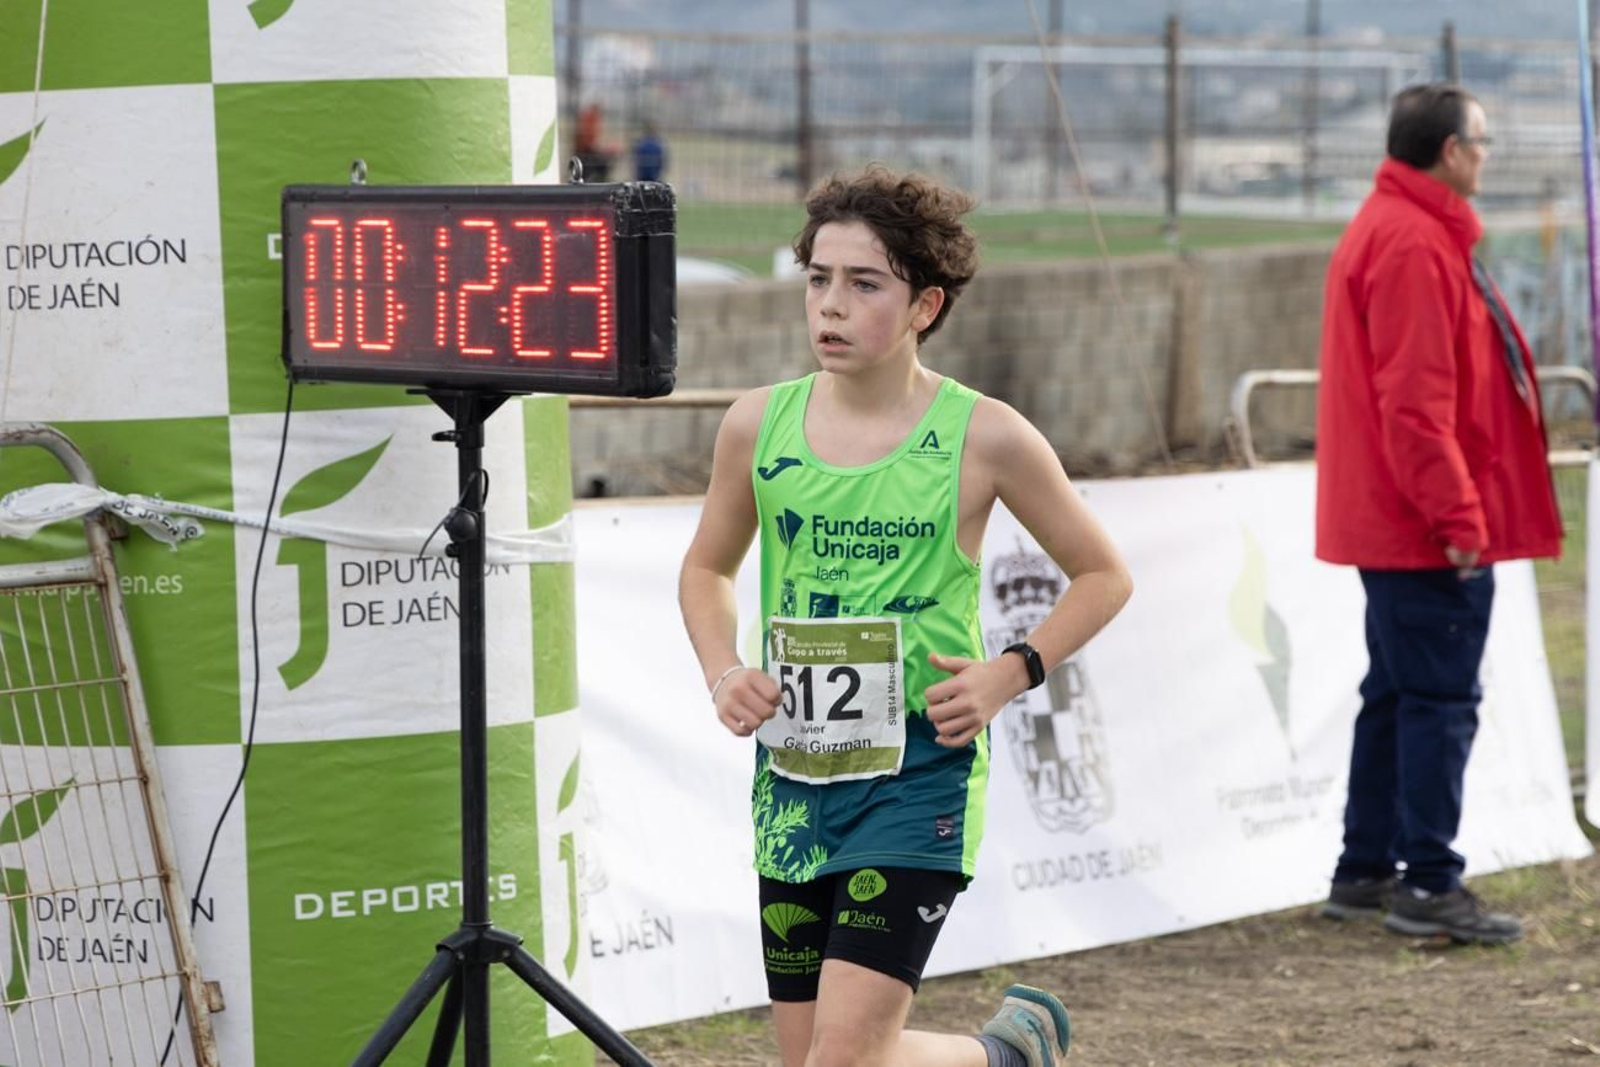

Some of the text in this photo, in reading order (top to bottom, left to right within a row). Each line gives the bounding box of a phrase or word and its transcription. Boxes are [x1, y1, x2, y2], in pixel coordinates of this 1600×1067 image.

[6, 235, 187, 270] DIPUTACIÓN
[8, 277, 121, 310] DE JAÉN
[304, 218, 609, 360] 00:12:23
[811, 514, 935, 538] Fundación
[811, 537, 900, 565] Unicaja
[815, 565, 849, 582] Jaén
[342, 600, 385, 627] DE
[816, 647, 848, 657] través
[780, 665, 863, 721] 512
[810, 737, 871, 754] Guzman
[850, 910, 886, 926] Jaén
[38, 933, 148, 963] DE JAÉN
[766, 946, 819, 963] Unicaja
